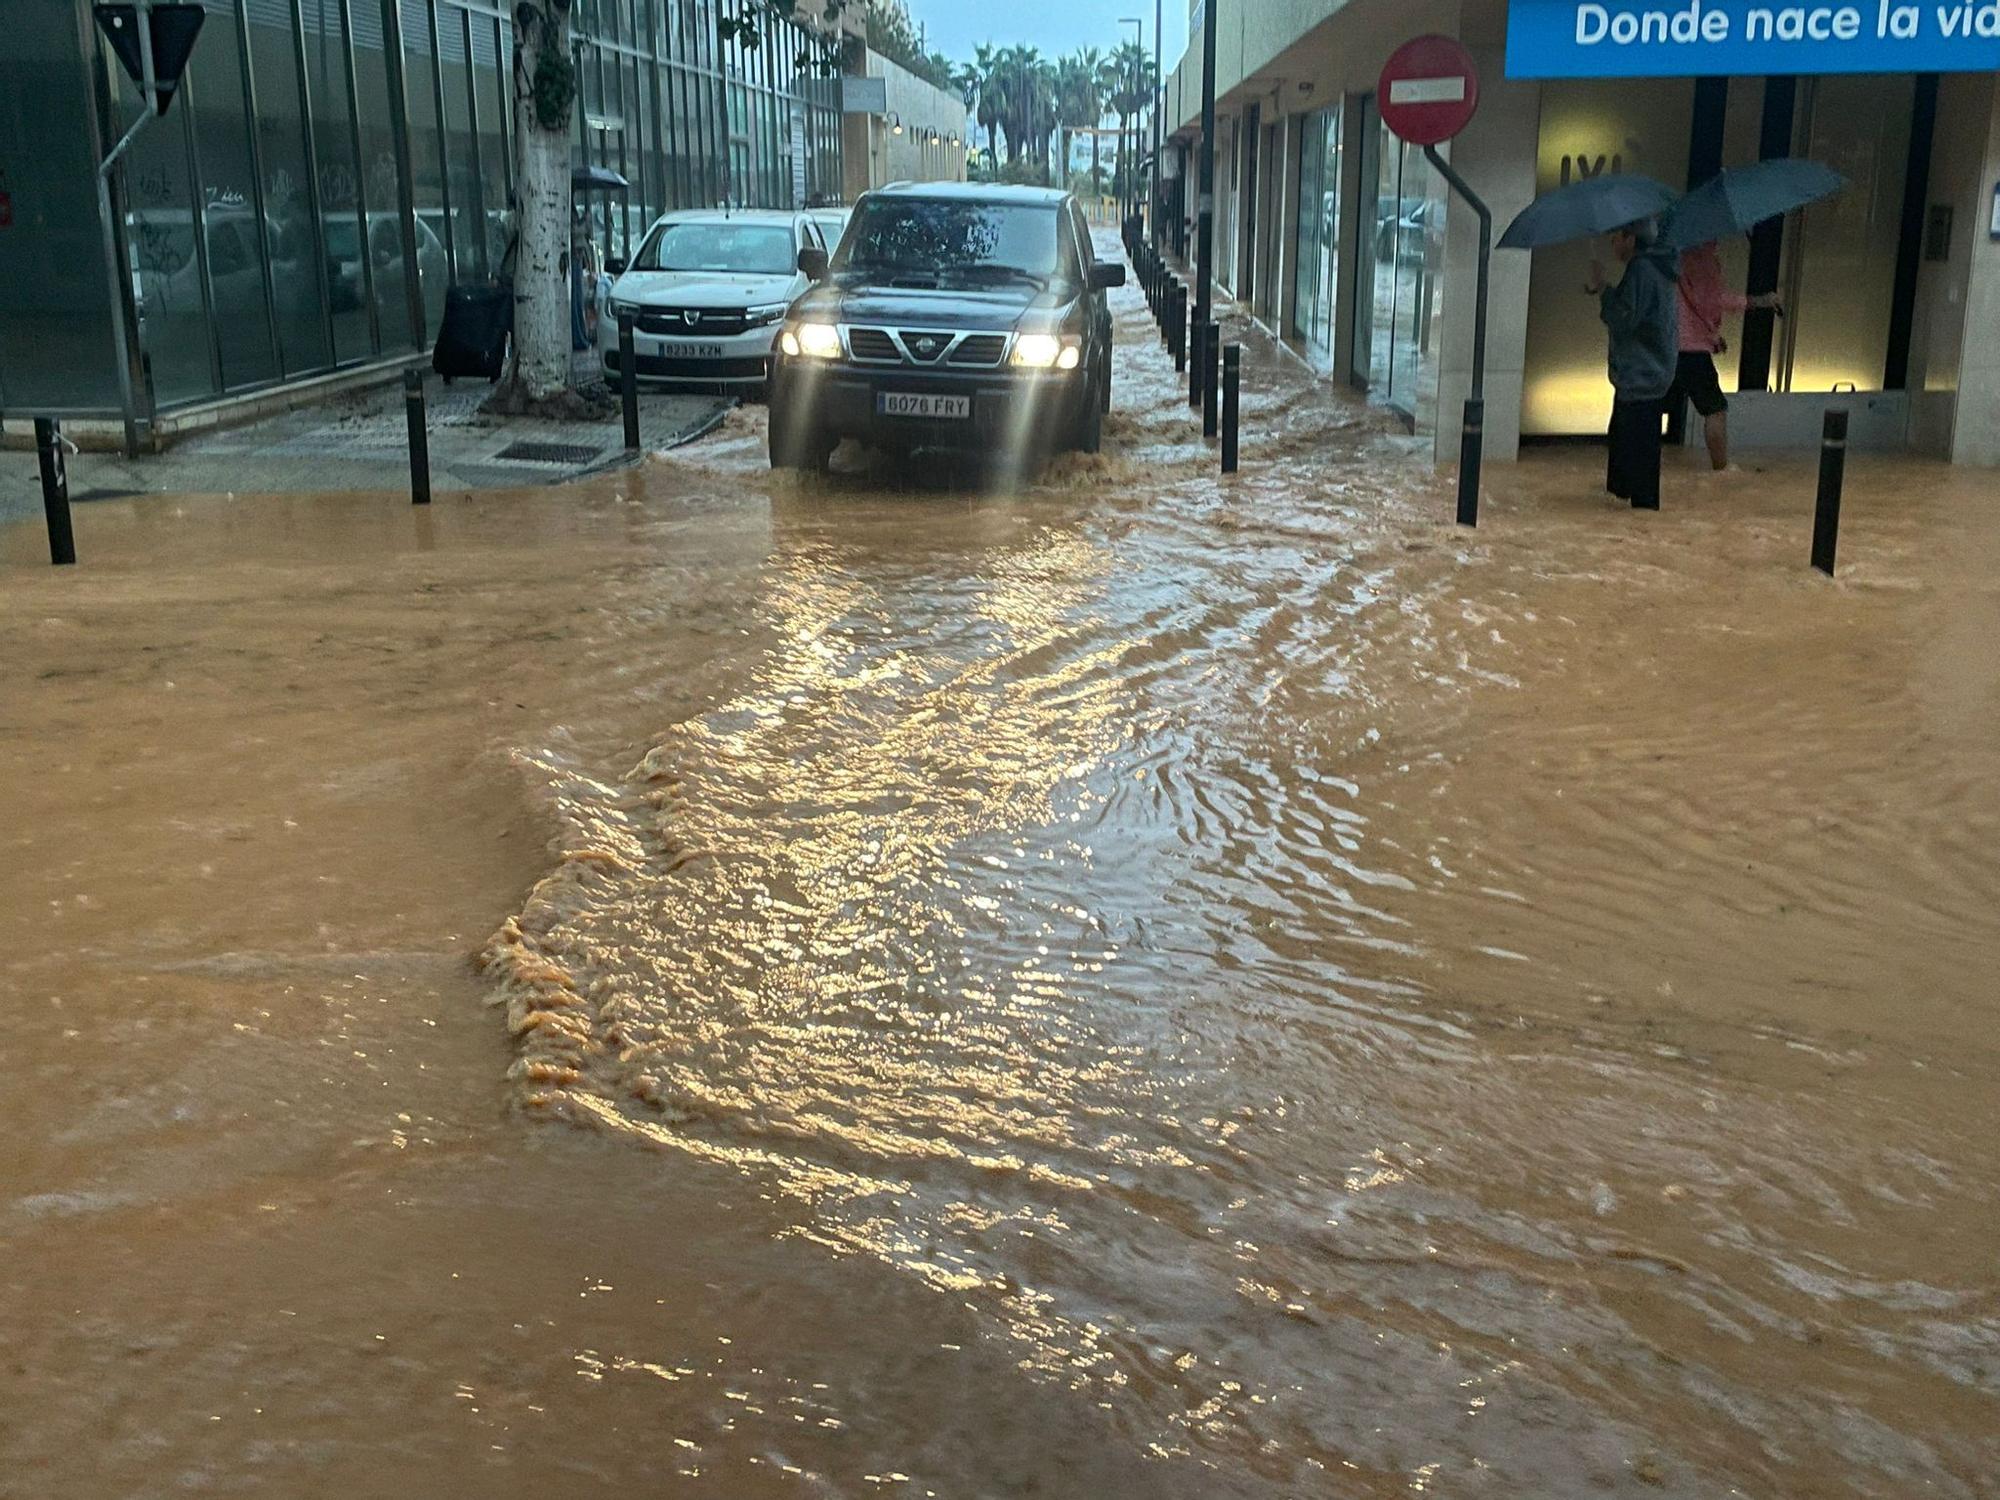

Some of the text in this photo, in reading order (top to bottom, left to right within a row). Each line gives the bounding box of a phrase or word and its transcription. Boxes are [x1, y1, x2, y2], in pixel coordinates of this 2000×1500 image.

[1575, 0, 1730, 46] Donde
[1745, 5, 1861, 41] nace
[1876, 0, 1920, 39] la
[934, 396, 965, 415] FRY
